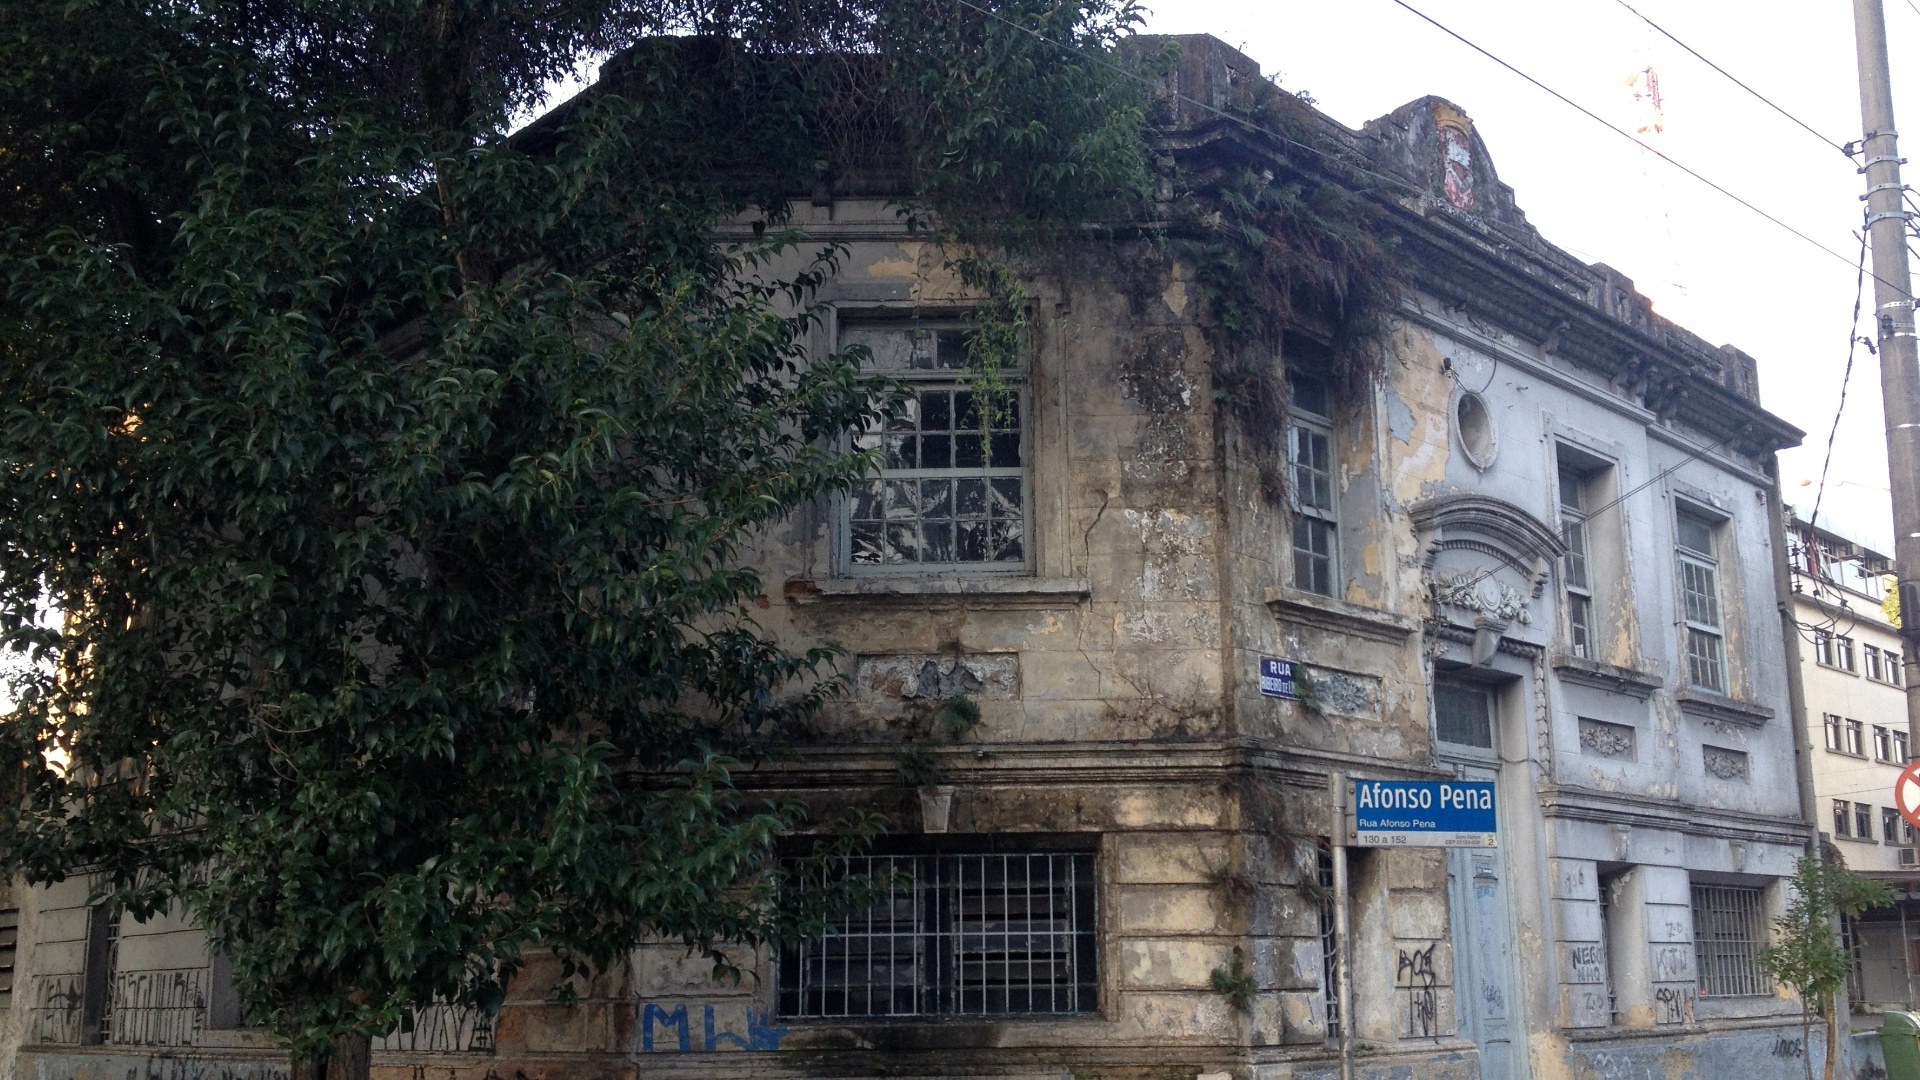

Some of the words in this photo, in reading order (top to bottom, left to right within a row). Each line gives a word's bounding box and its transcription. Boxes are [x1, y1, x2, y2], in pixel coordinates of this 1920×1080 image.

[1270, 661, 1291, 676] RUA
[1359, 782, 1432, 809] Afonso
[1440, 784, 1492, 810] Pena
[1359, 819, 1378, 828] Rua
[1379, 819, 1411, 828] Afonso
[1412, 819, 1436, 828] Pena
[1363, 835, 1380, 844] 130
[1391, 835, 1407, 844] 152
[1488, 838, 1494, 846] 2
